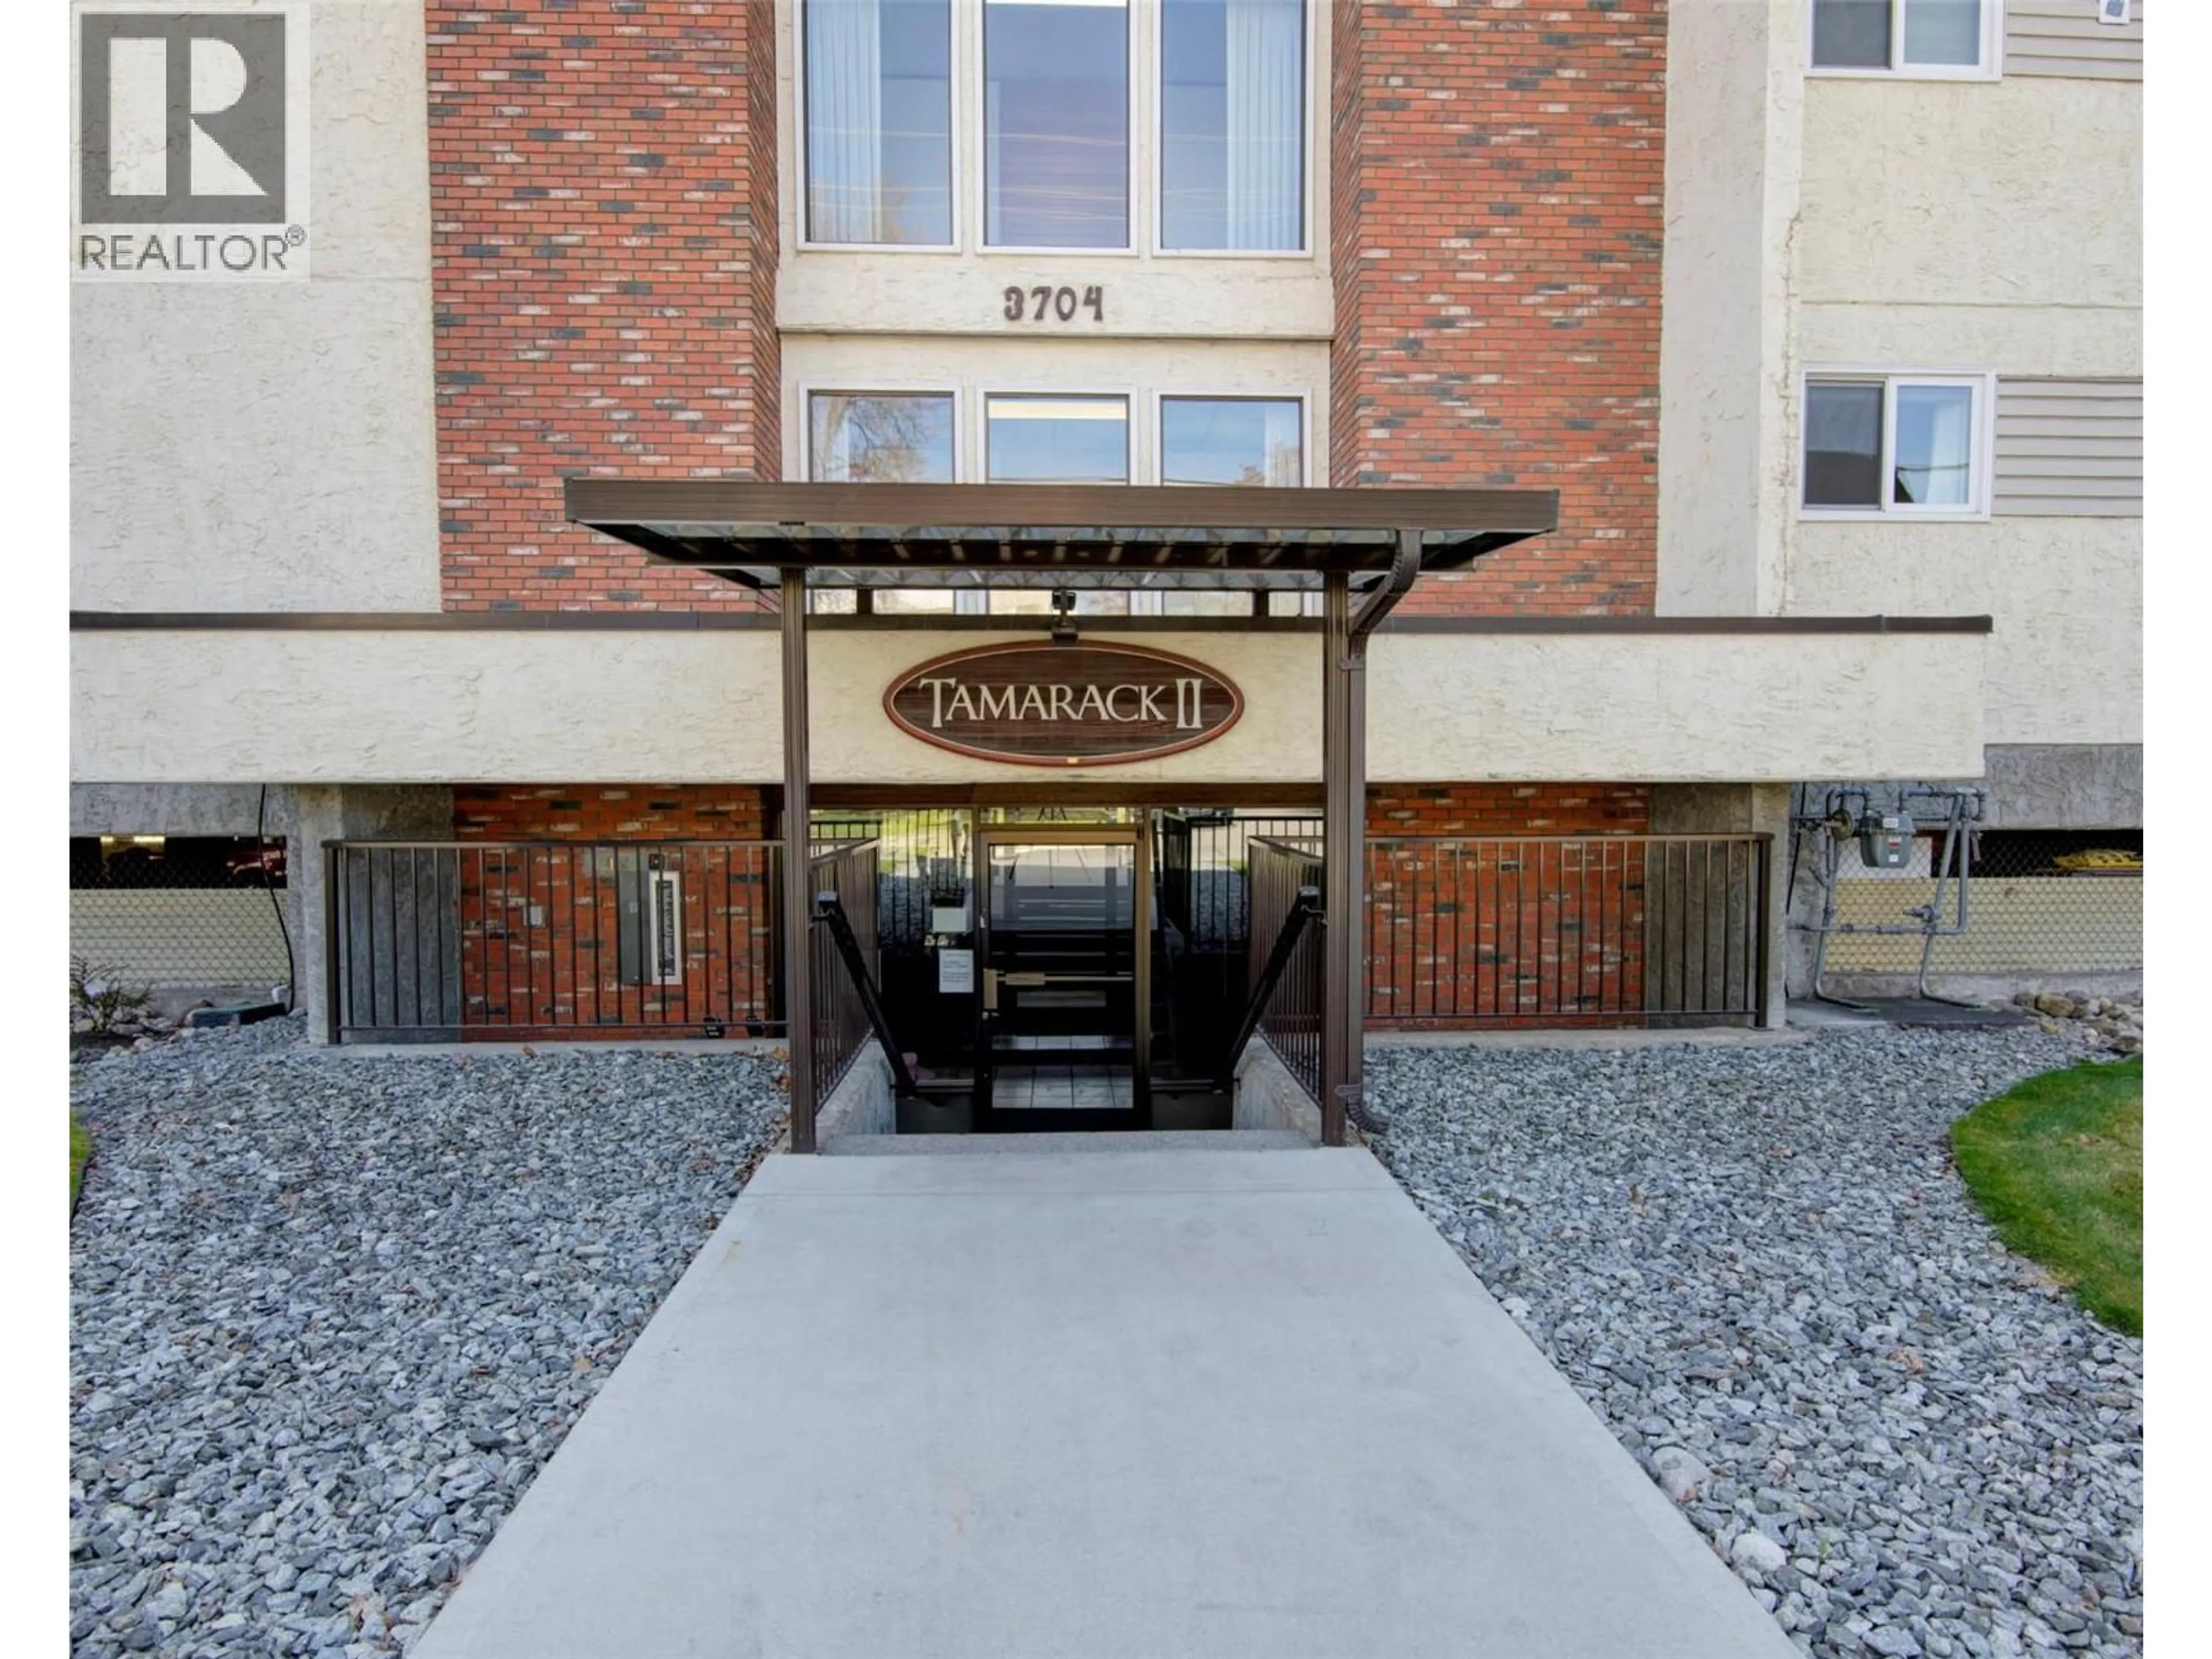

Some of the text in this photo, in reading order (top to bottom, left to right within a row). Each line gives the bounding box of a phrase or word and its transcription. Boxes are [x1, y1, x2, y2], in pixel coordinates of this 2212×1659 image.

[1004, 286, 1103, 321] 3704
[919, 677, 1203, 729] TAMARACK II
